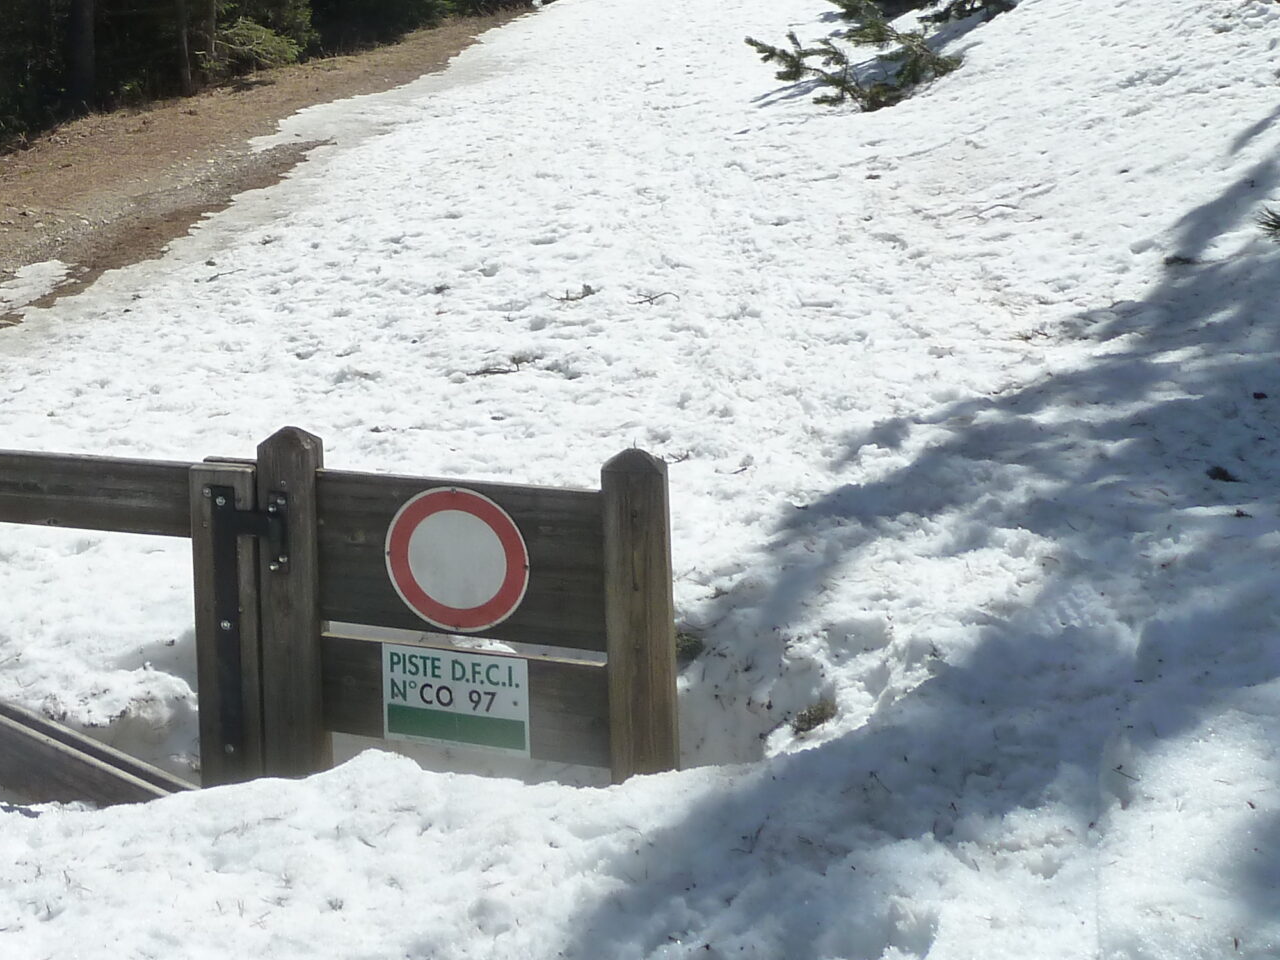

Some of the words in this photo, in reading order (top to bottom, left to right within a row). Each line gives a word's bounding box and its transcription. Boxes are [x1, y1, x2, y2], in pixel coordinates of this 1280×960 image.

[389, 651, 442, 679] PISTE
[451, 658, 520, 689] D.F.C.I.
[468, 690, 497, 713] 97
